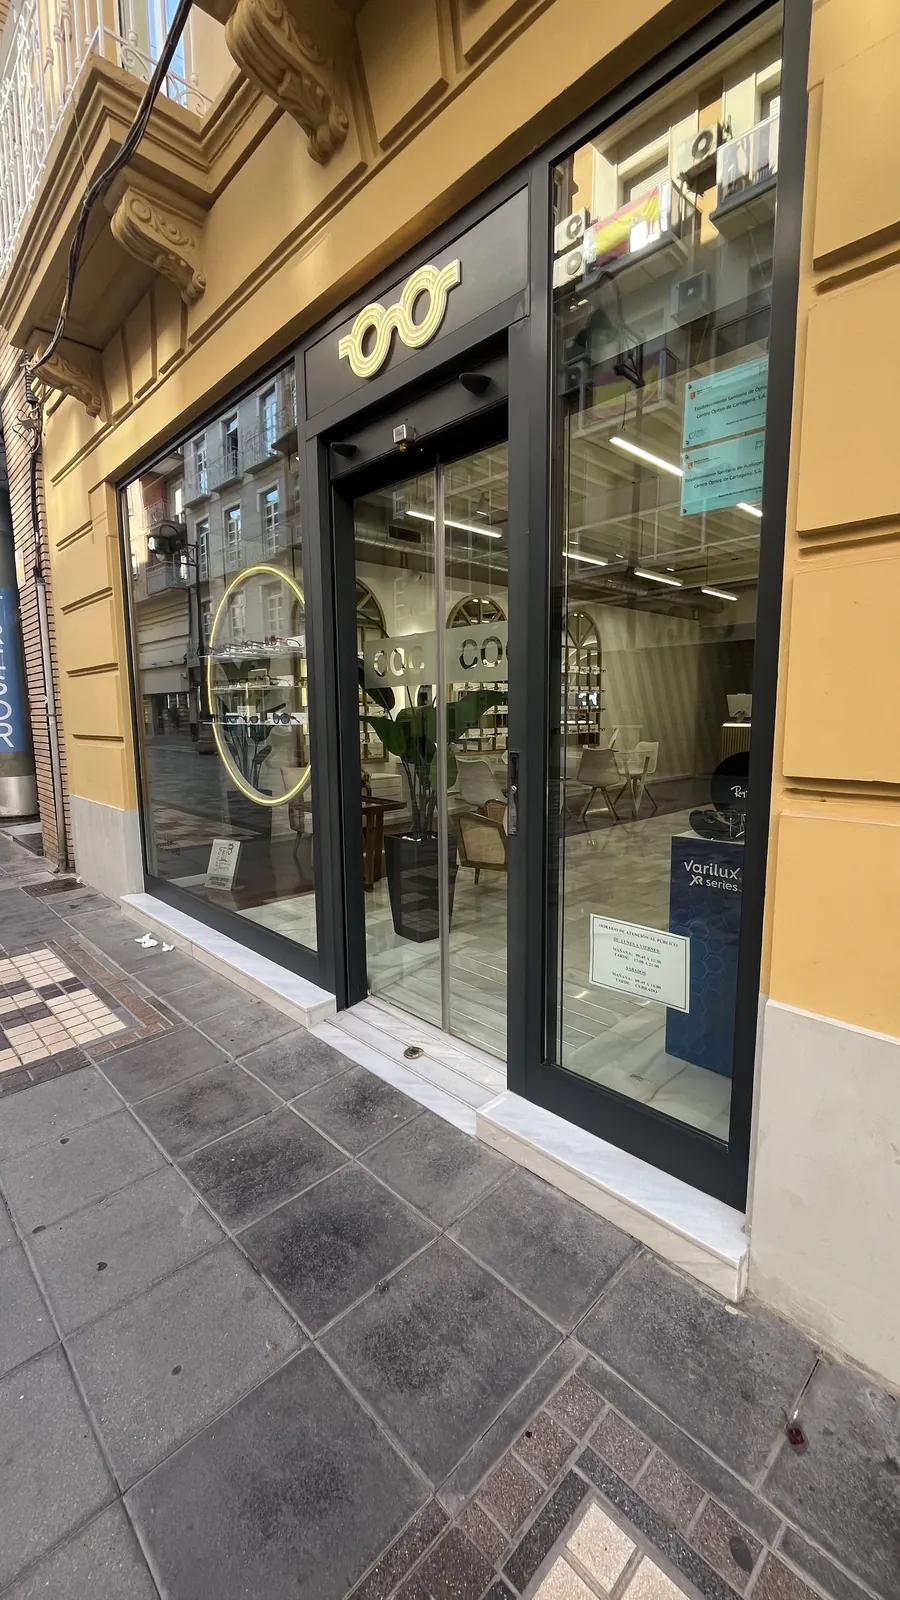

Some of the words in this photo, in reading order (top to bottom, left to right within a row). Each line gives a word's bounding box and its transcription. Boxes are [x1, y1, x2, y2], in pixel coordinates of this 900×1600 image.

[684, 860, 740, 881] Varilux
[689, 874, 704, 887] XR
[706, 880, 738, 892] series
[599, 923, 618, 932] HORARIO
